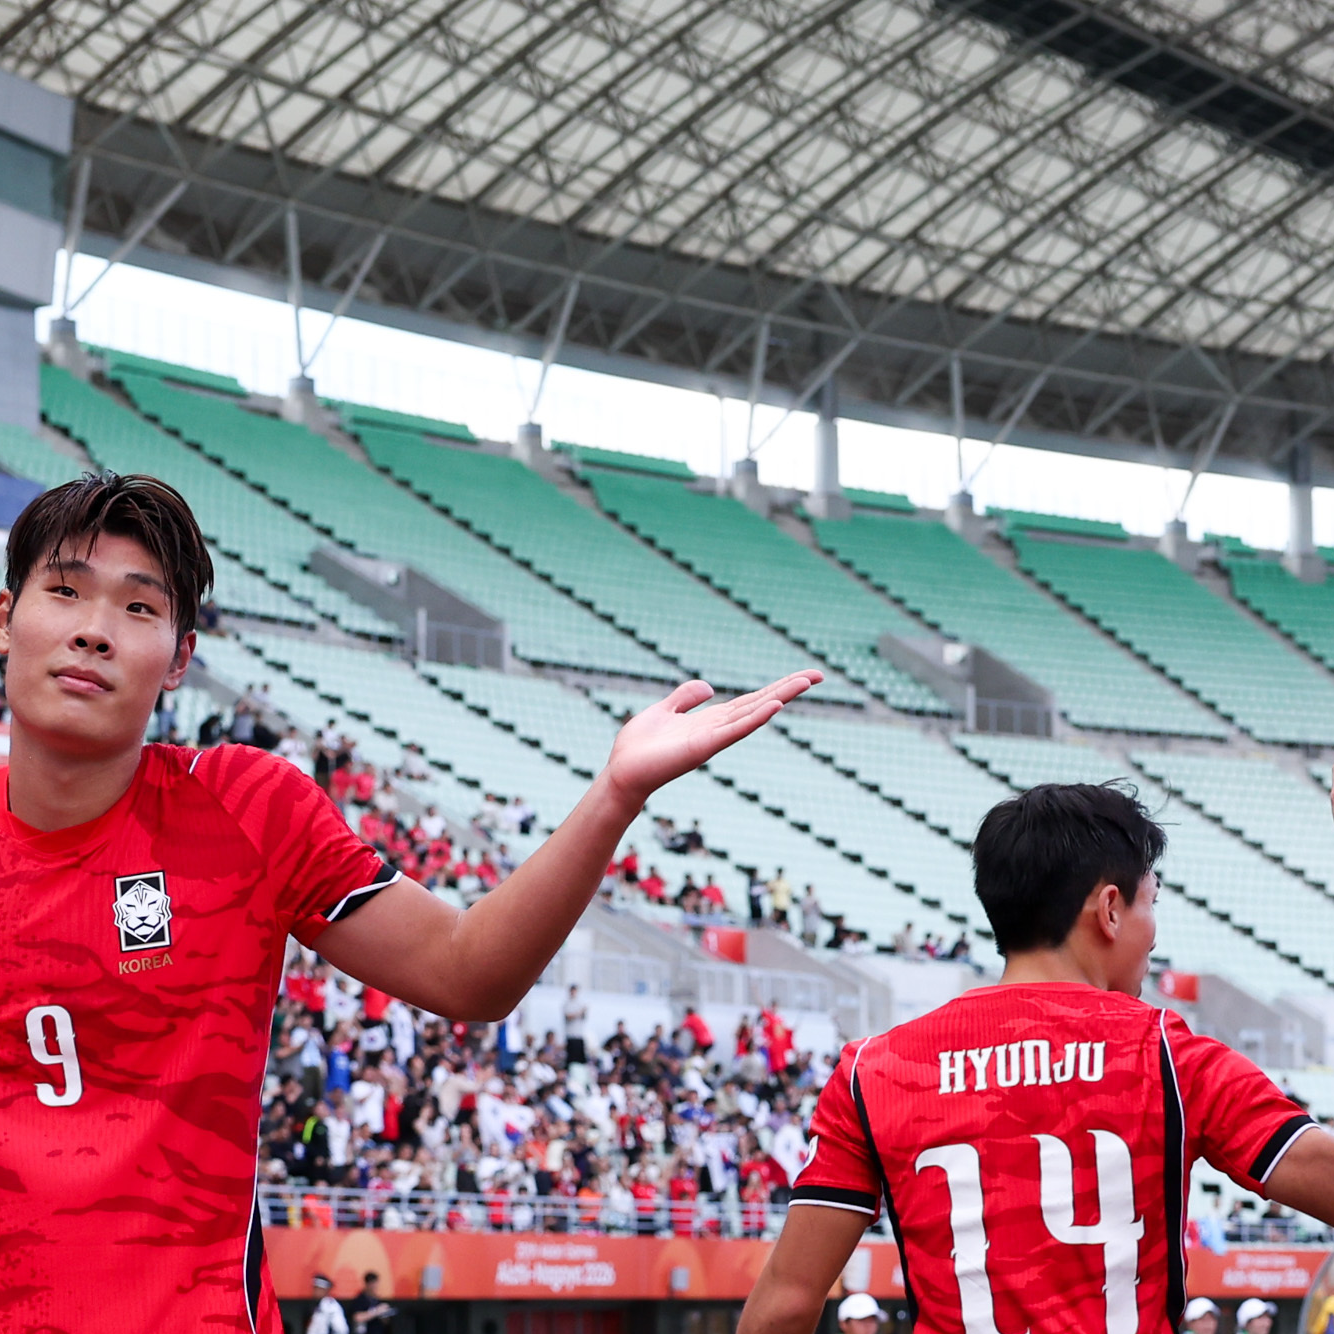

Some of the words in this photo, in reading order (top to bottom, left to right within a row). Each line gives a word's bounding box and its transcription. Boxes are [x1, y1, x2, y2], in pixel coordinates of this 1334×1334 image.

[118, 953, 173, 975] KOREA
[25, 1004, 84, 1107] 9
[937, 1039, 1106, 1095] HYUNJU
